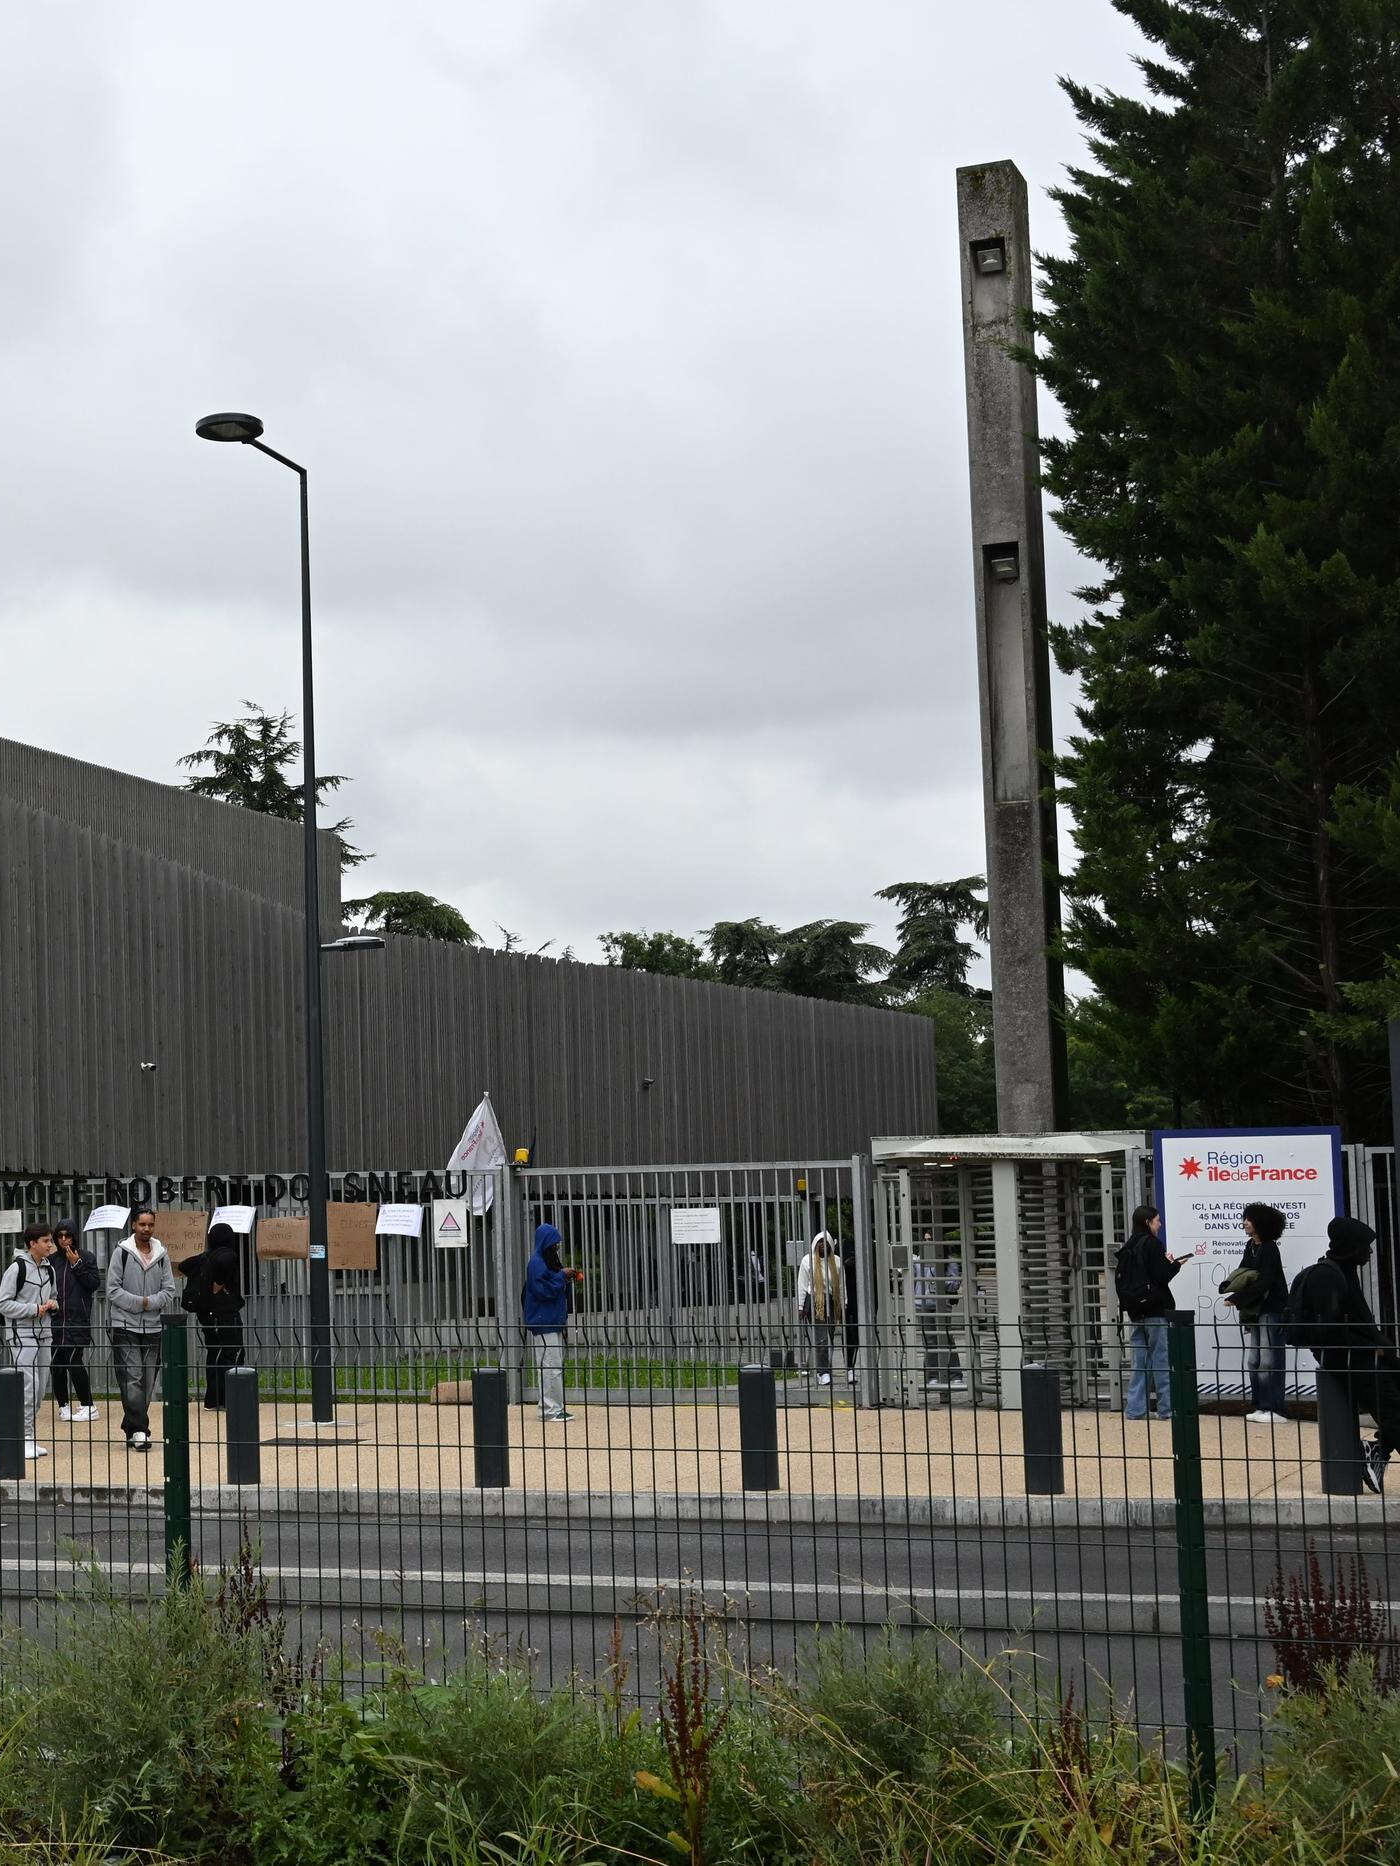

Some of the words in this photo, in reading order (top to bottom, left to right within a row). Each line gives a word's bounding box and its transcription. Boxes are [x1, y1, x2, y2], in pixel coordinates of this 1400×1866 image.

[1207, 1151, 1264, 1168] Région
[106, 1174, 248, 1204] ROBERT
[265, 1170, 467, 1203] DOSNEAU
[1192, 1202, 1207, 1212] ICI,
[1209, 1203, 1221, 1211] LA
[1270, 1202, 1306, 1210] INVESTI
[1211, 1213, 1243, 1221] MILLIO
[1204, 1222, 1230, 1231] DANS
